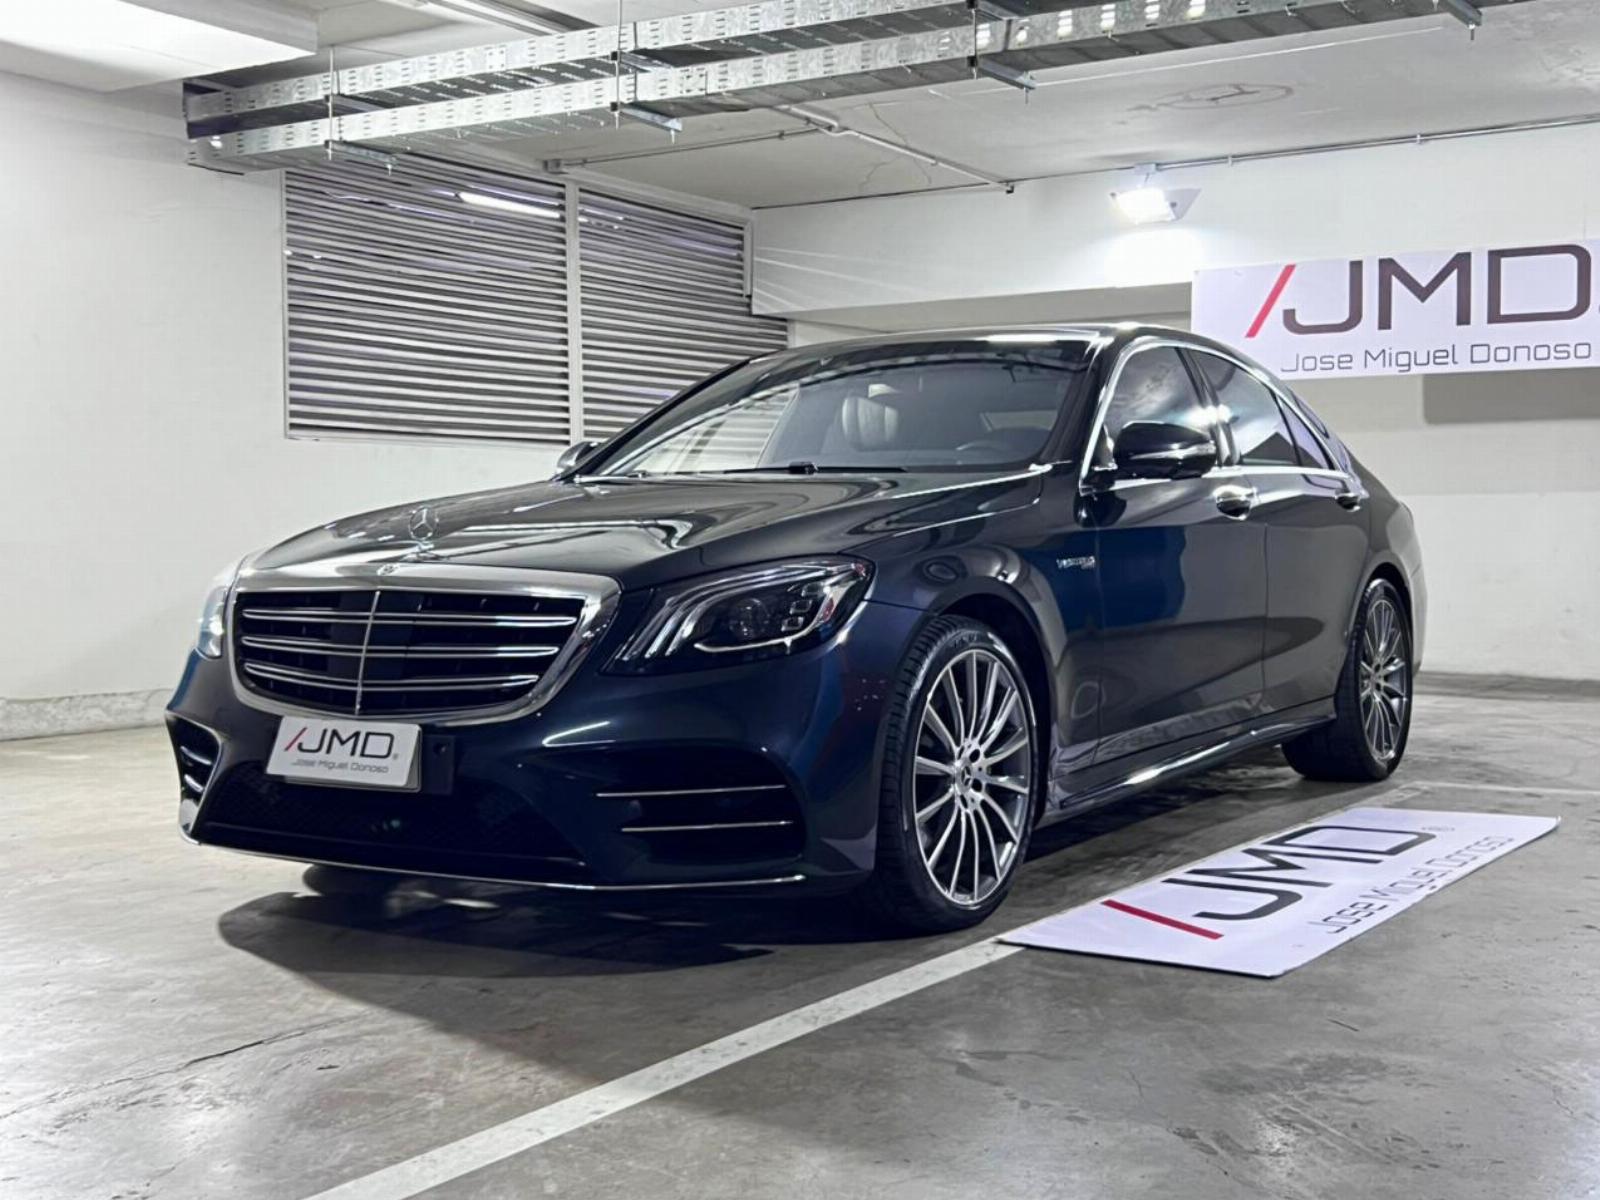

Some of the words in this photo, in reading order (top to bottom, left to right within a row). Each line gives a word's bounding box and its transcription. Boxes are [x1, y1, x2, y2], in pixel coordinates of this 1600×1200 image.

[1280, 353, 1353, 373] Jose
[1363, 344, 1459, 373] Miguel
[1470, 342, 1592, 364] Donoso
[318, 760, 349, 770] Miguel
[350, 762, 390, 773] Donoso
[1307, 901, 1389, 934] Jose
